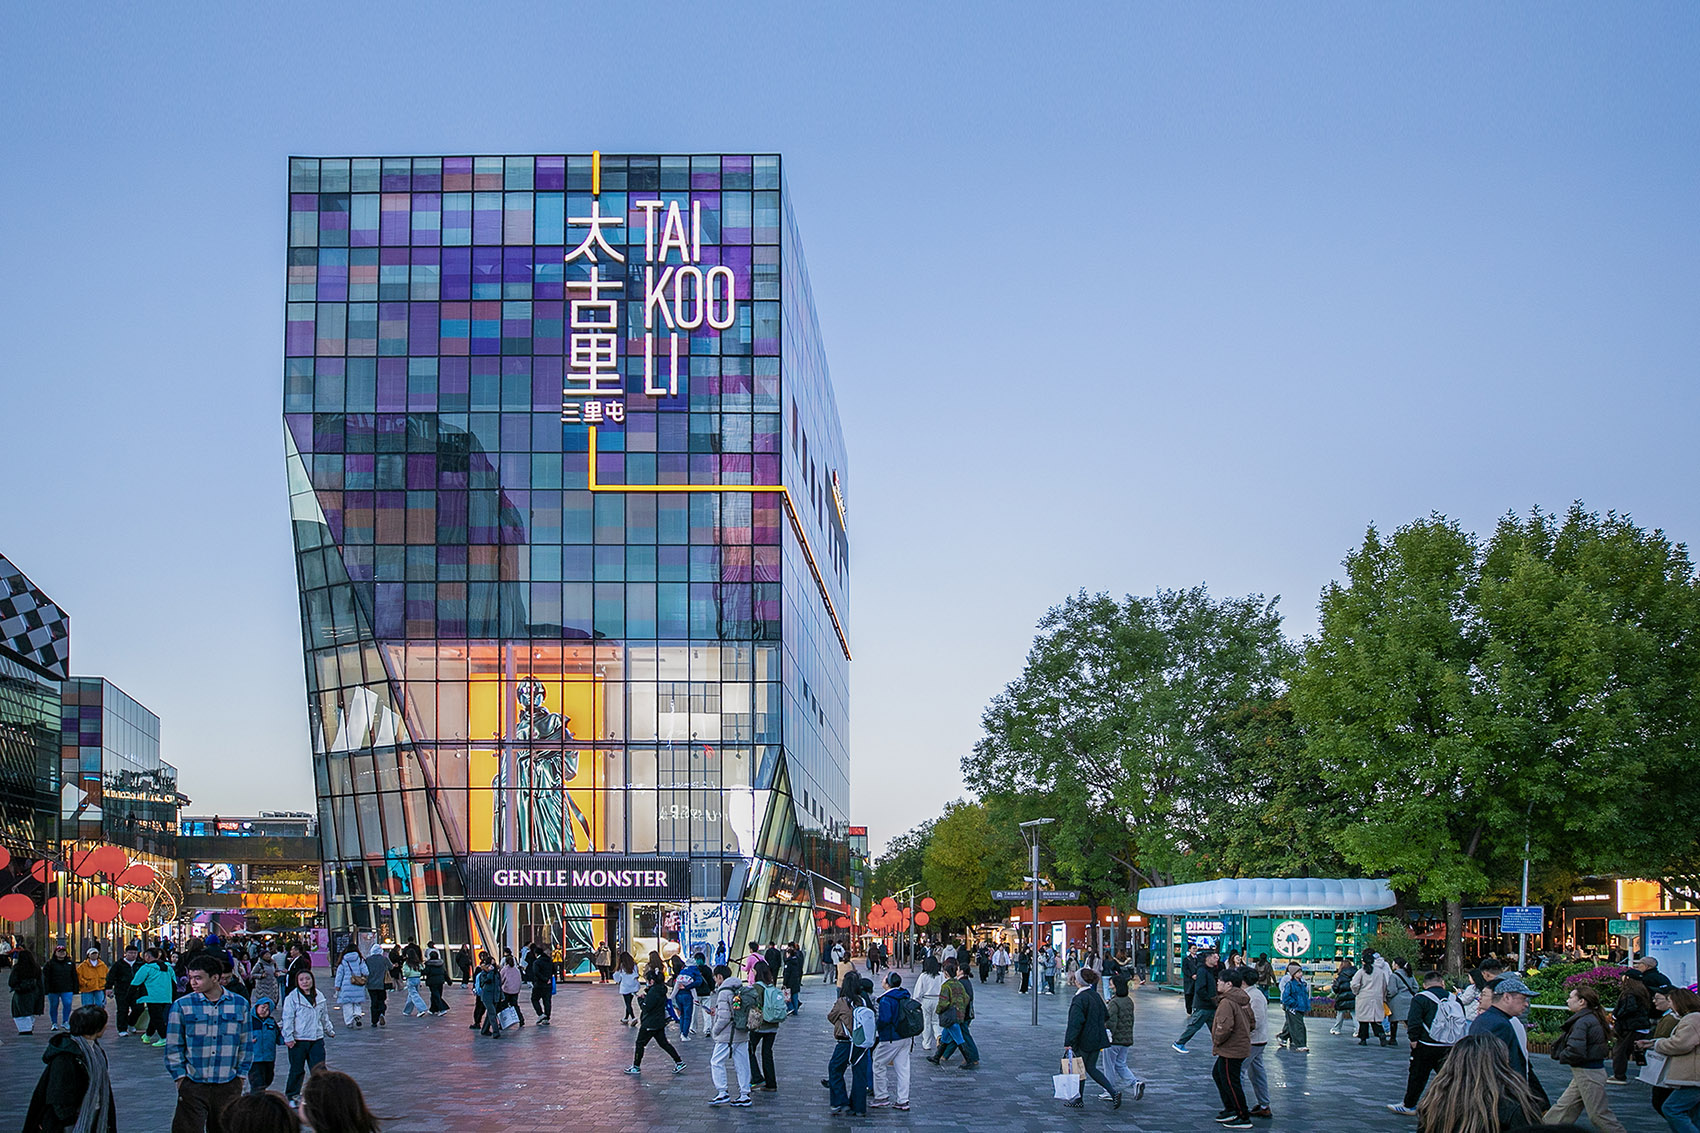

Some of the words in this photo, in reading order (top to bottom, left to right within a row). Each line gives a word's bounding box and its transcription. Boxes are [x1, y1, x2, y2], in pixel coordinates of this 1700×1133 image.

[636, 200, 701, 262] TAI
[563, 201, 624, 395] 太古里
[644, 266, 735, 329] KOO
[644, 332, 678, 395] LI
[561, 400, 624, 423] 三里屯
[493, 870, 567, 887] GENTLE
[572, 870, 668, 887] MONSTER
